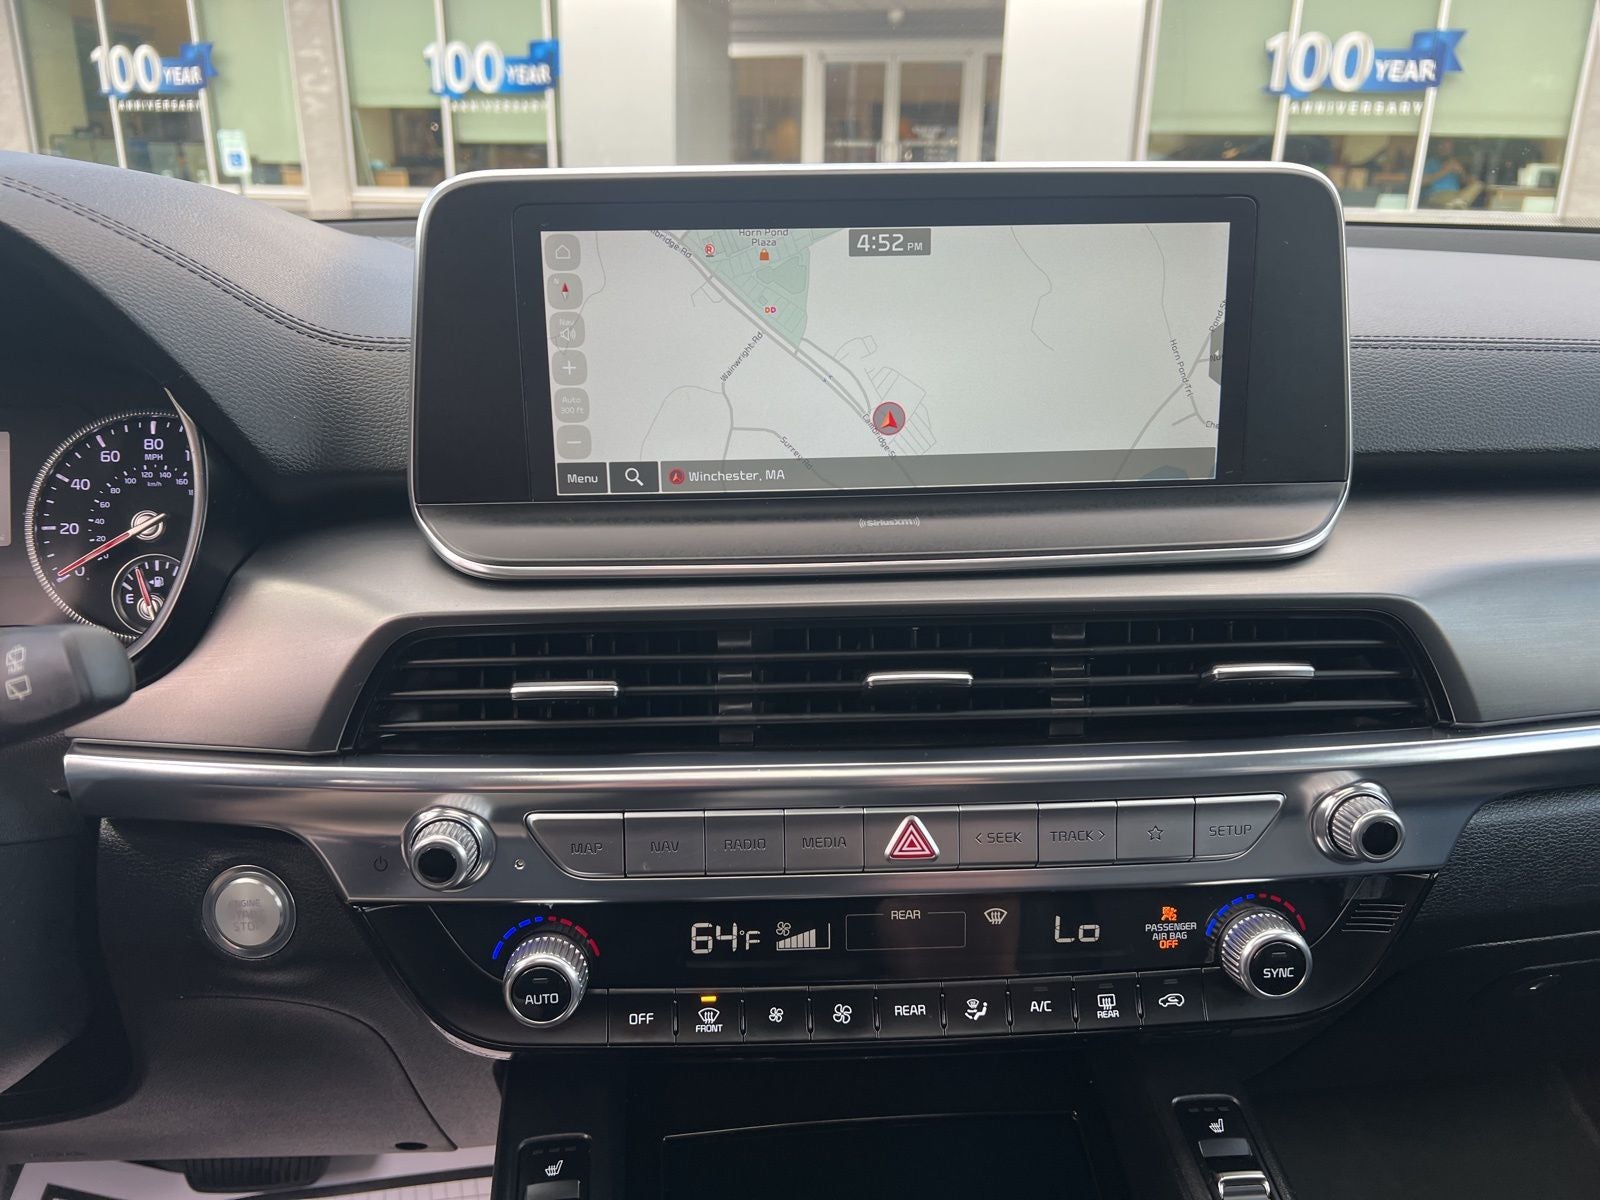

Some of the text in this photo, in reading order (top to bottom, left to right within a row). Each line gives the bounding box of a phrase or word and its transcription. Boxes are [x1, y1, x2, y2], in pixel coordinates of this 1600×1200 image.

[422, 41, 552, 93] 100 YEAR
[1265, 31, 1437, 92] 100 YEAR
[90, 44, 202, 93] 100 YEAR
[1288, 101, 1424, 116] ANNIVERSARY
[738, 227, 789, 237] Horn Pond
[751, 238, 777, 247] Plaza
[856, 232, 923, 252] 4:52 PM
[680, 247, 693, 259] Rd
[1208, 309, 1224, 333] Pond
[720, 331, 764, 382] Wainwright Rd
[1170, 339, 1182, 361] Horn
[1178, 361, 1190, 384] Pond
[562, 396, 581, 404] Auto
[576, 405, 585, 415] ft
[144, 438, 164, 450] 80
[780, 435, 803, 461] Surrey
[100, 450, 121, 463] 60
[144, 453, 164, 461] MPH
[124, 477, 137, 485] 100
[141, 471, 154, 479] 120
[159, 471, 172, 479] 140
[567, 473, 599, 484] Menu
[688, 470, 786, 483] Winchester, MA
[70, 479, 91, 490] 40
[175, 478, 189, 486] 160
[99, 501, 111, 509] 60
[94, 517, 105, 525] 40
[59, 522, 80, 534] 20
[96, 535, 107, 543] 20
[125, 593, 135, 605] E
[1049, 829, 1094, 842] TRACK
[1209, 823, 1253, 838] SETUP
[801, 835, 847, 850] MEDIA
[986, 831, 1022, 844] SEEK
[570, 842, 603, 856] MAP
[650, 840, 680, 854] NAV
[723, 837, 767, 852] RADIO
[890, 909, 921, 920] REAR
[1054, 914, 1100, 943] Lo
[1145, 922, 1197, 932] PASSENGER
[1152, 931, 1188, 941] AIR BAG
[1159, 940, 1179, 949] OFF
[1263, 967, 1295, 979] SYNC
[524, 993, 559, 1006] AUTO
[894, 1004, 927, 1017] REAR
[1030, 1000, 1052, 1013] A/C
[628, 1013, 655, 1025] OFF
[1096, 1010, 1120, 1019] REAR
[695, 1023, 724, 1033] FRONT
